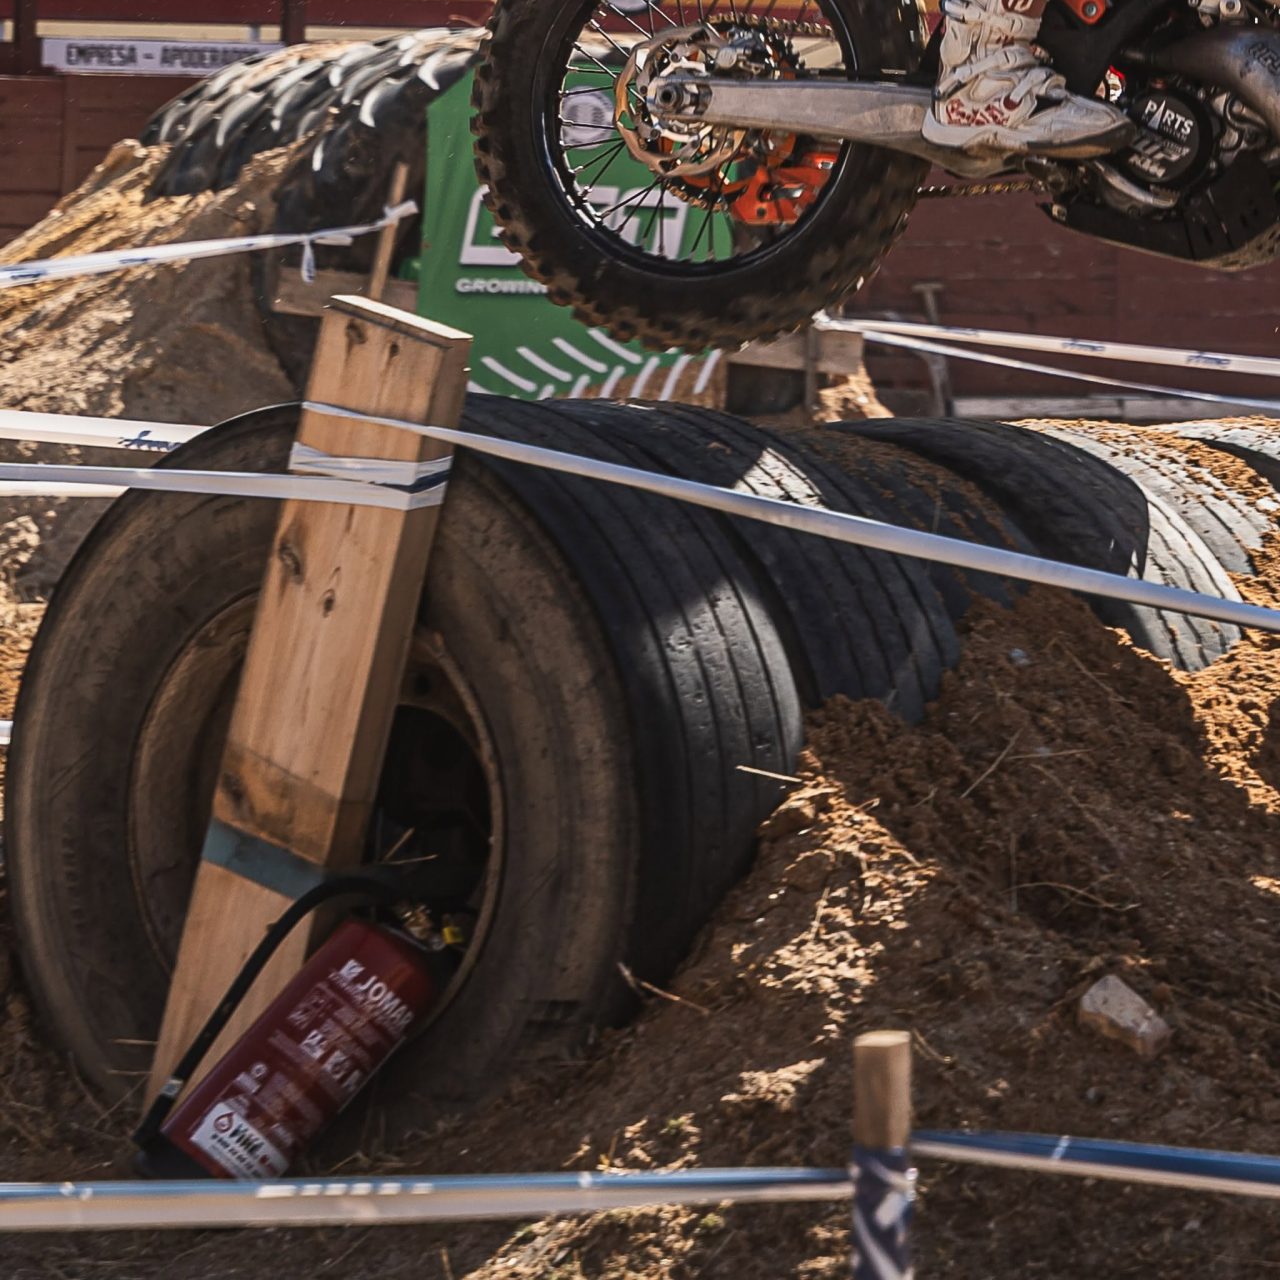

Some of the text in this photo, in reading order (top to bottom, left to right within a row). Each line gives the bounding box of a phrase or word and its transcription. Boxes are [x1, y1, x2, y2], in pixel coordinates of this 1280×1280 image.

[66, 43, 137, 66] EMPRESA
[1144, 99, 1194, 135] PARTS
[454, 276, 549, 294] GROWIN
